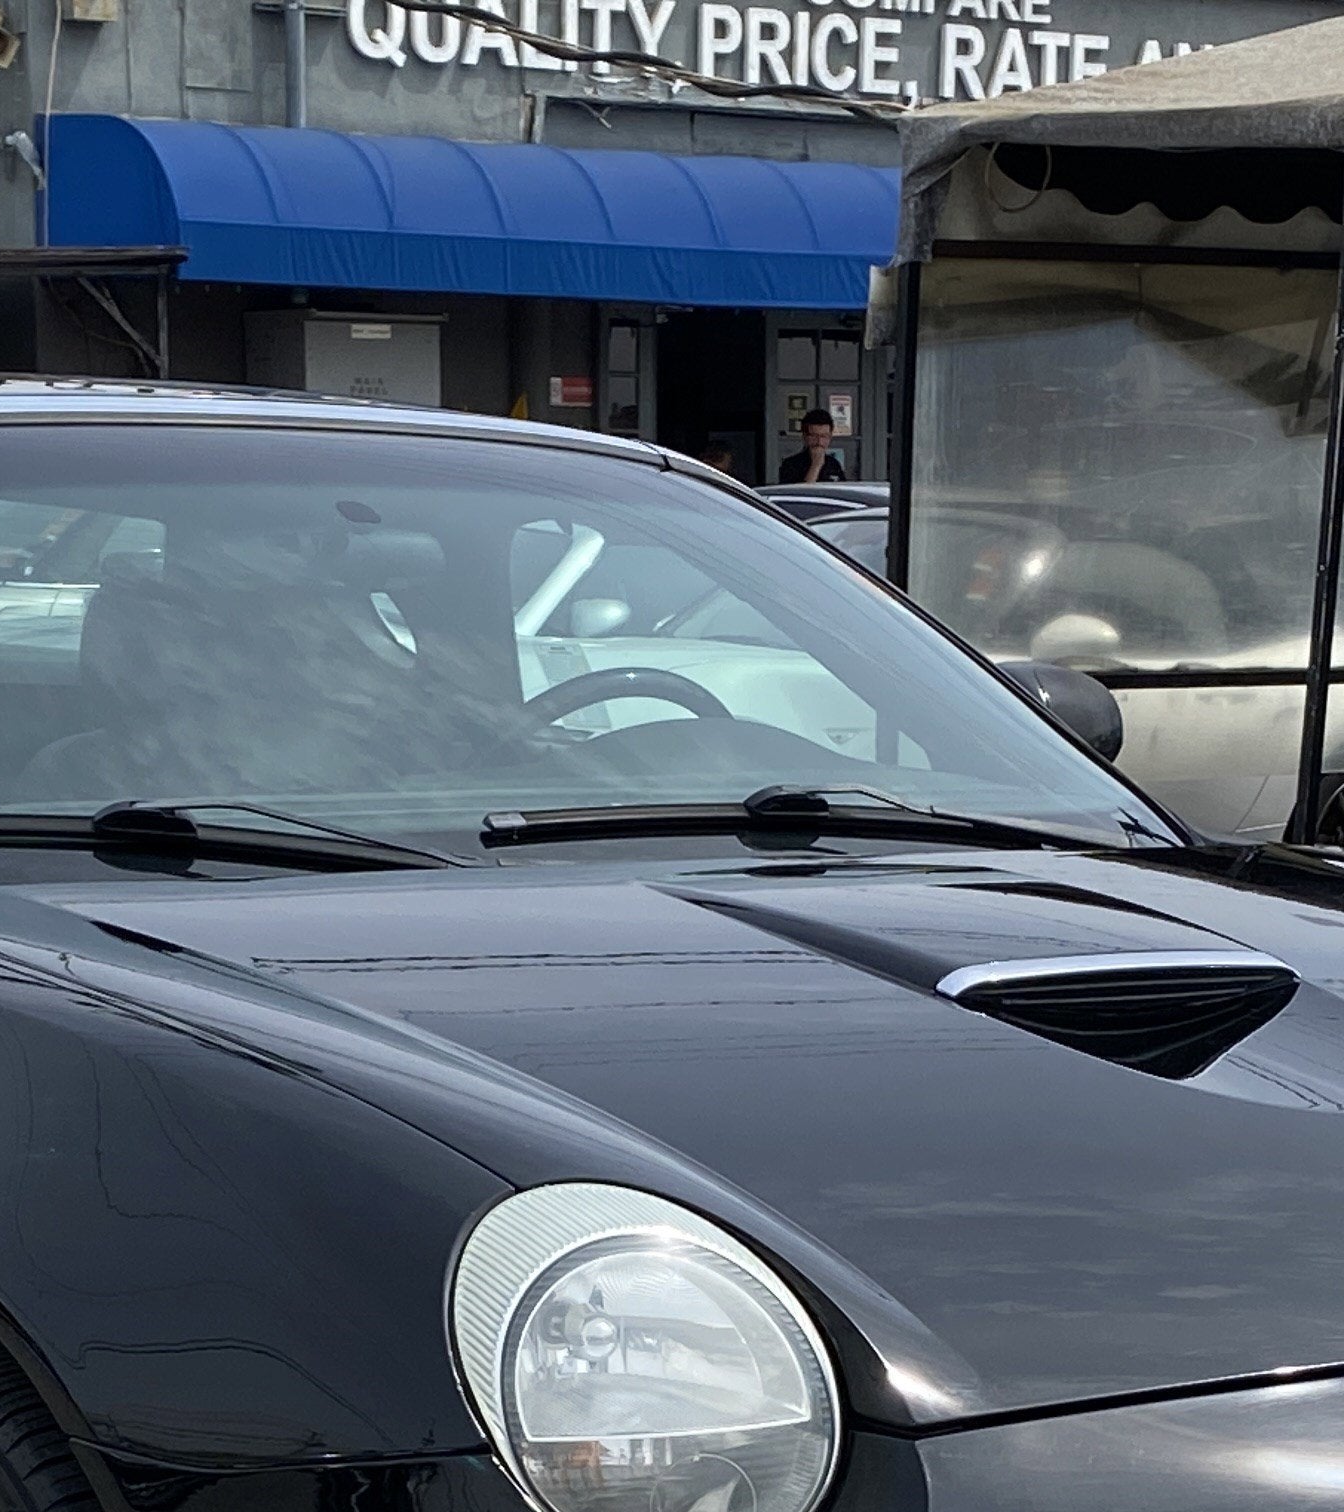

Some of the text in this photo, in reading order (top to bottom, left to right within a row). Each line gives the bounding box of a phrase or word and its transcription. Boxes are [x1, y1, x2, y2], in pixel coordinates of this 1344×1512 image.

[347, 0, 1110, 111] QUALITY PRICE, RATE
